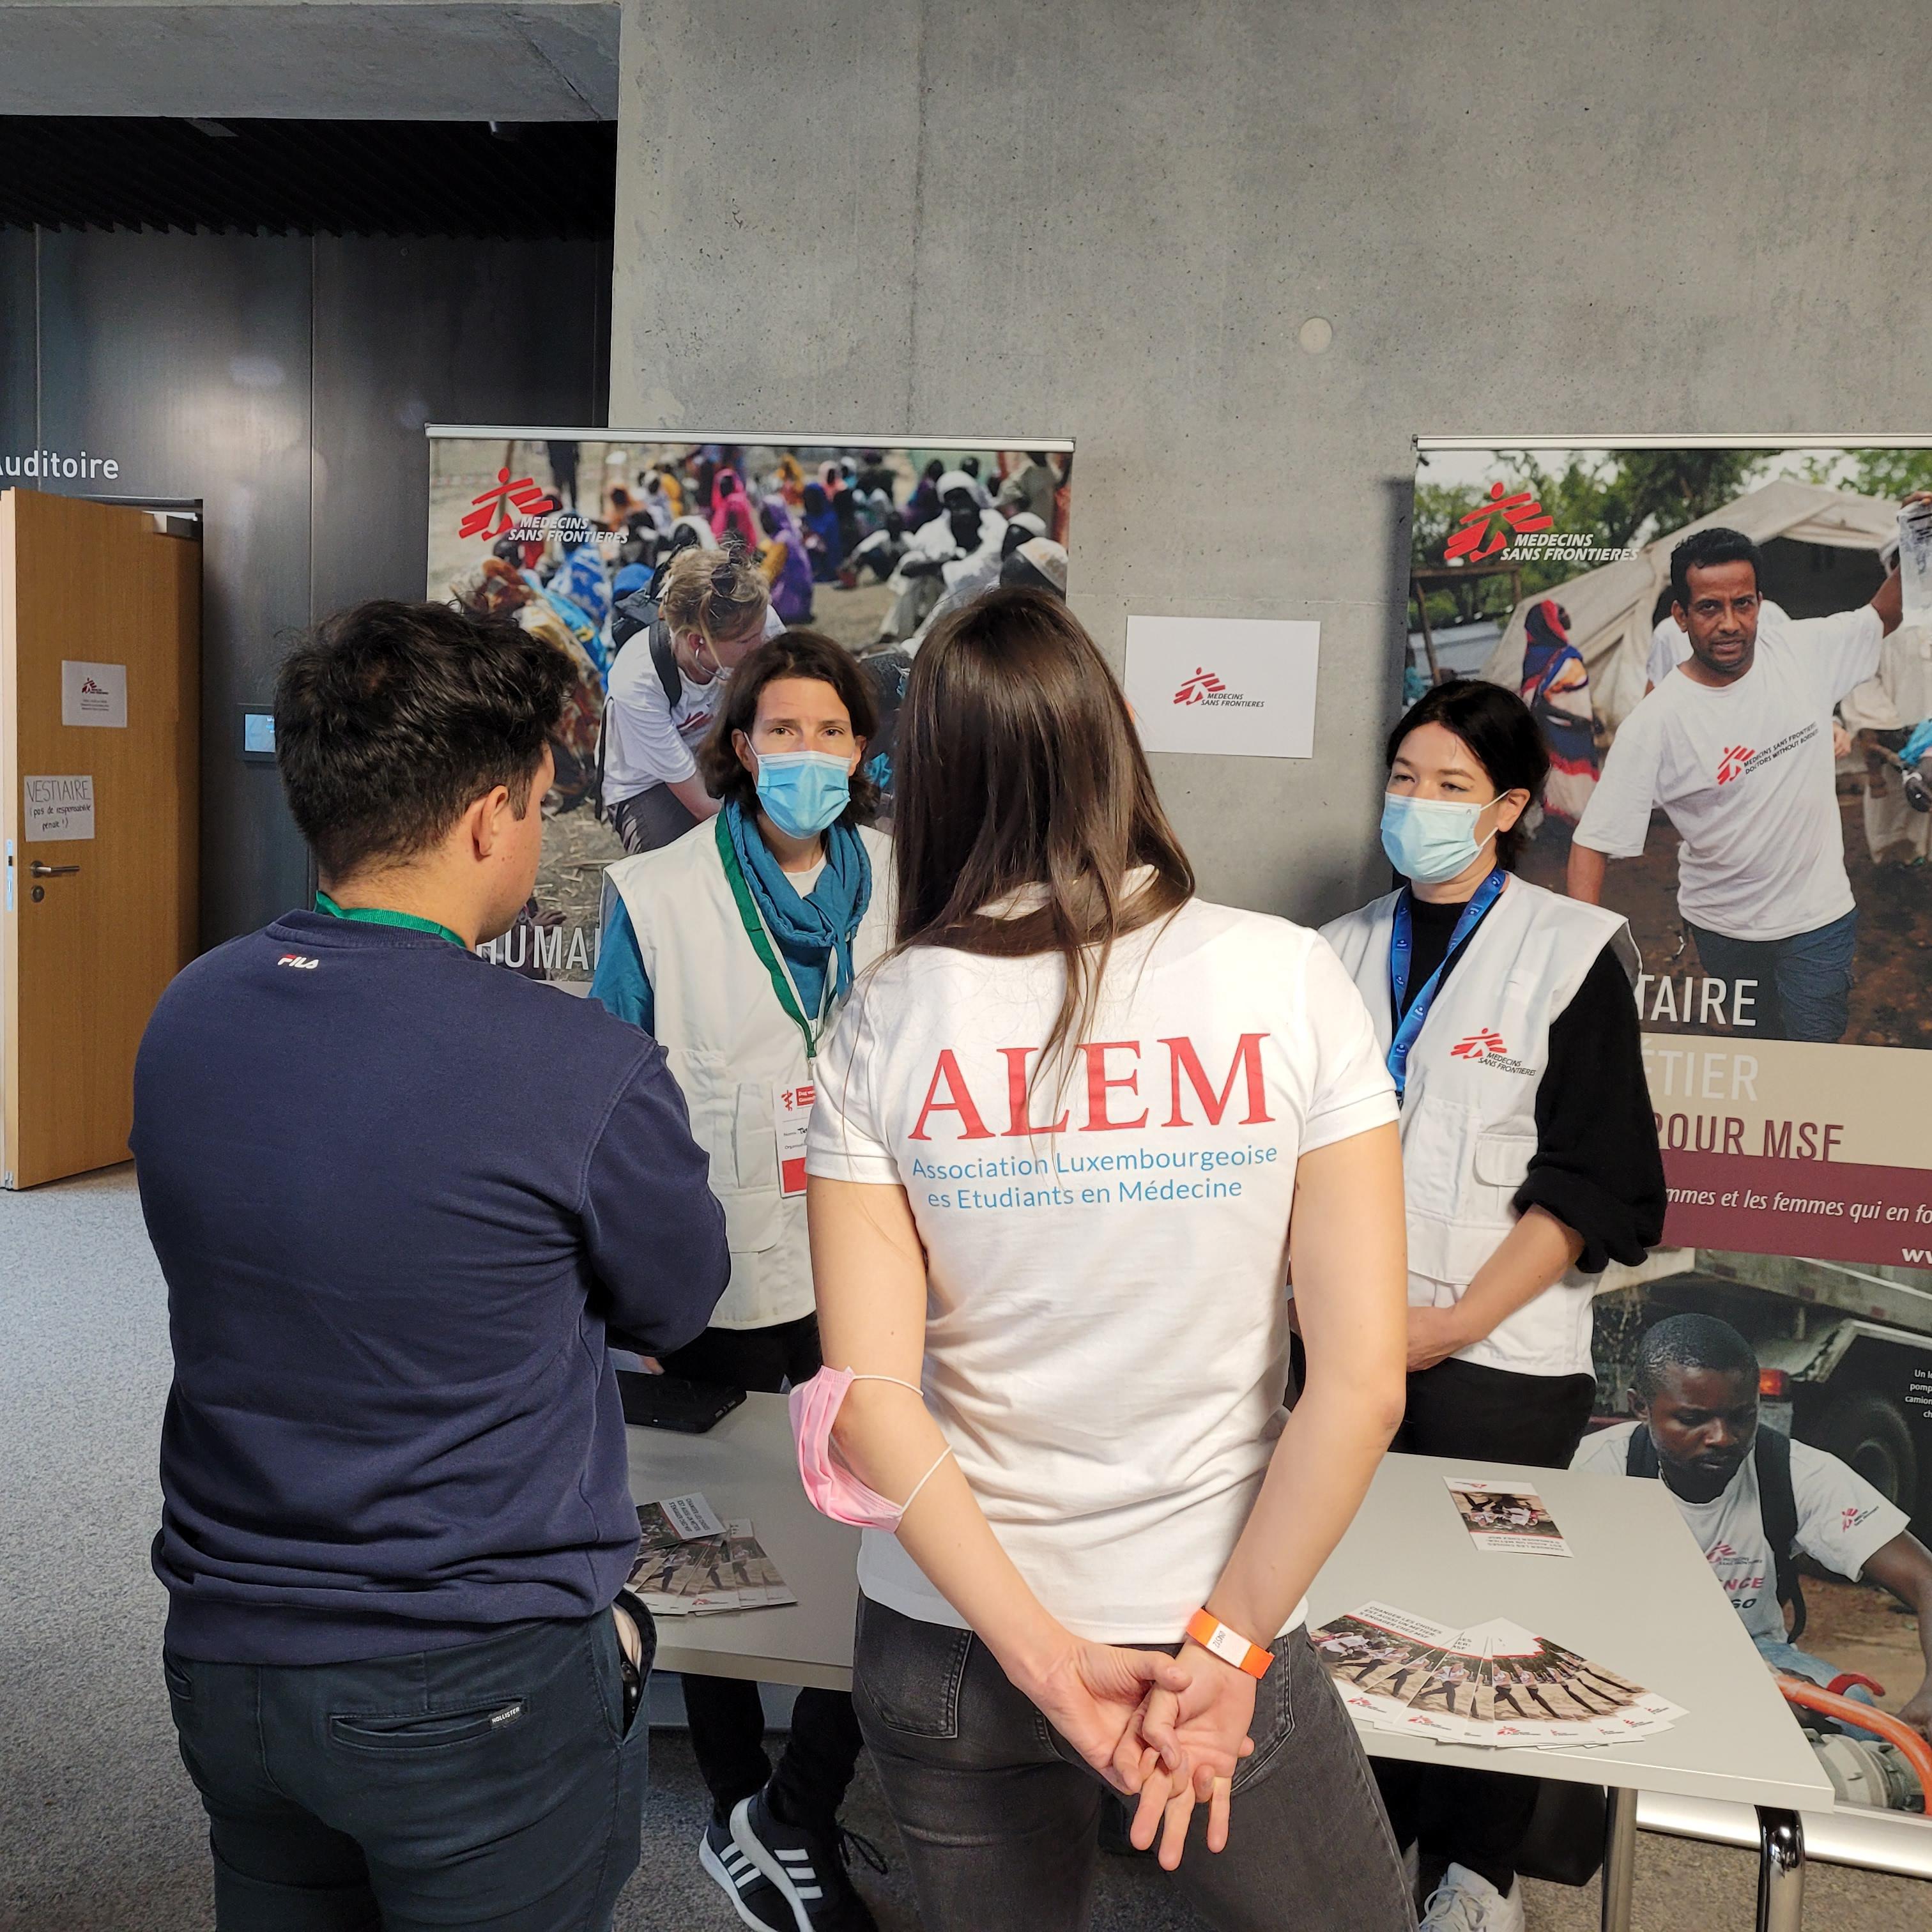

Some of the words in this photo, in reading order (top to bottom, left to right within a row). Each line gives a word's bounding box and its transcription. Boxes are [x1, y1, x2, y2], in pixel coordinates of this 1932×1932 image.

[0, 450, 119, 479] uditoire
[520, 516, 590, 530] MEDECINS
[508, 529, 544, 542] SANS
[546, 530, 629, 544] FRONTIERES
[1514, 534, 1593, 547] MEDECINS
[1500, 548, 1542, 560] SANS
[1543, 548, 1641, 561] FRONTIERES
[27, 779, 91, 802] VESTIAIRE
[277, 954, 319, 969] FILA
[1478, 1057, 1497, 1067] SANS
[1487, 1052, 1522, 1067] MEDECINS
[908, 1033, 1276, 1140] ALEM
[1763, 1119, 1844, 1162] MSF
[912, 1156, 1048, 1181] Association
[1057, 1144, 1278, 1174] Luxembourgeoise
[928, 1192, 950, 1208] es
[958, 1185, 1074, 1209] Etudiants
[1082, 1188, 1110, 1204] en
[1119, 1178, 1242, 1203] Médecine
[1721, 1190, 1739, 1207] et
[1743, 1190, 1768, 1209] les
[1772, 1192, 1845, 1216] femmes
[1850, 1200, 1882, 1223] qui
[1886, 1206, 1909, 1222] en
[1915, 1369, 1926, 1378] Un
[492, 1706, 520, 1724] HOLLISTER
